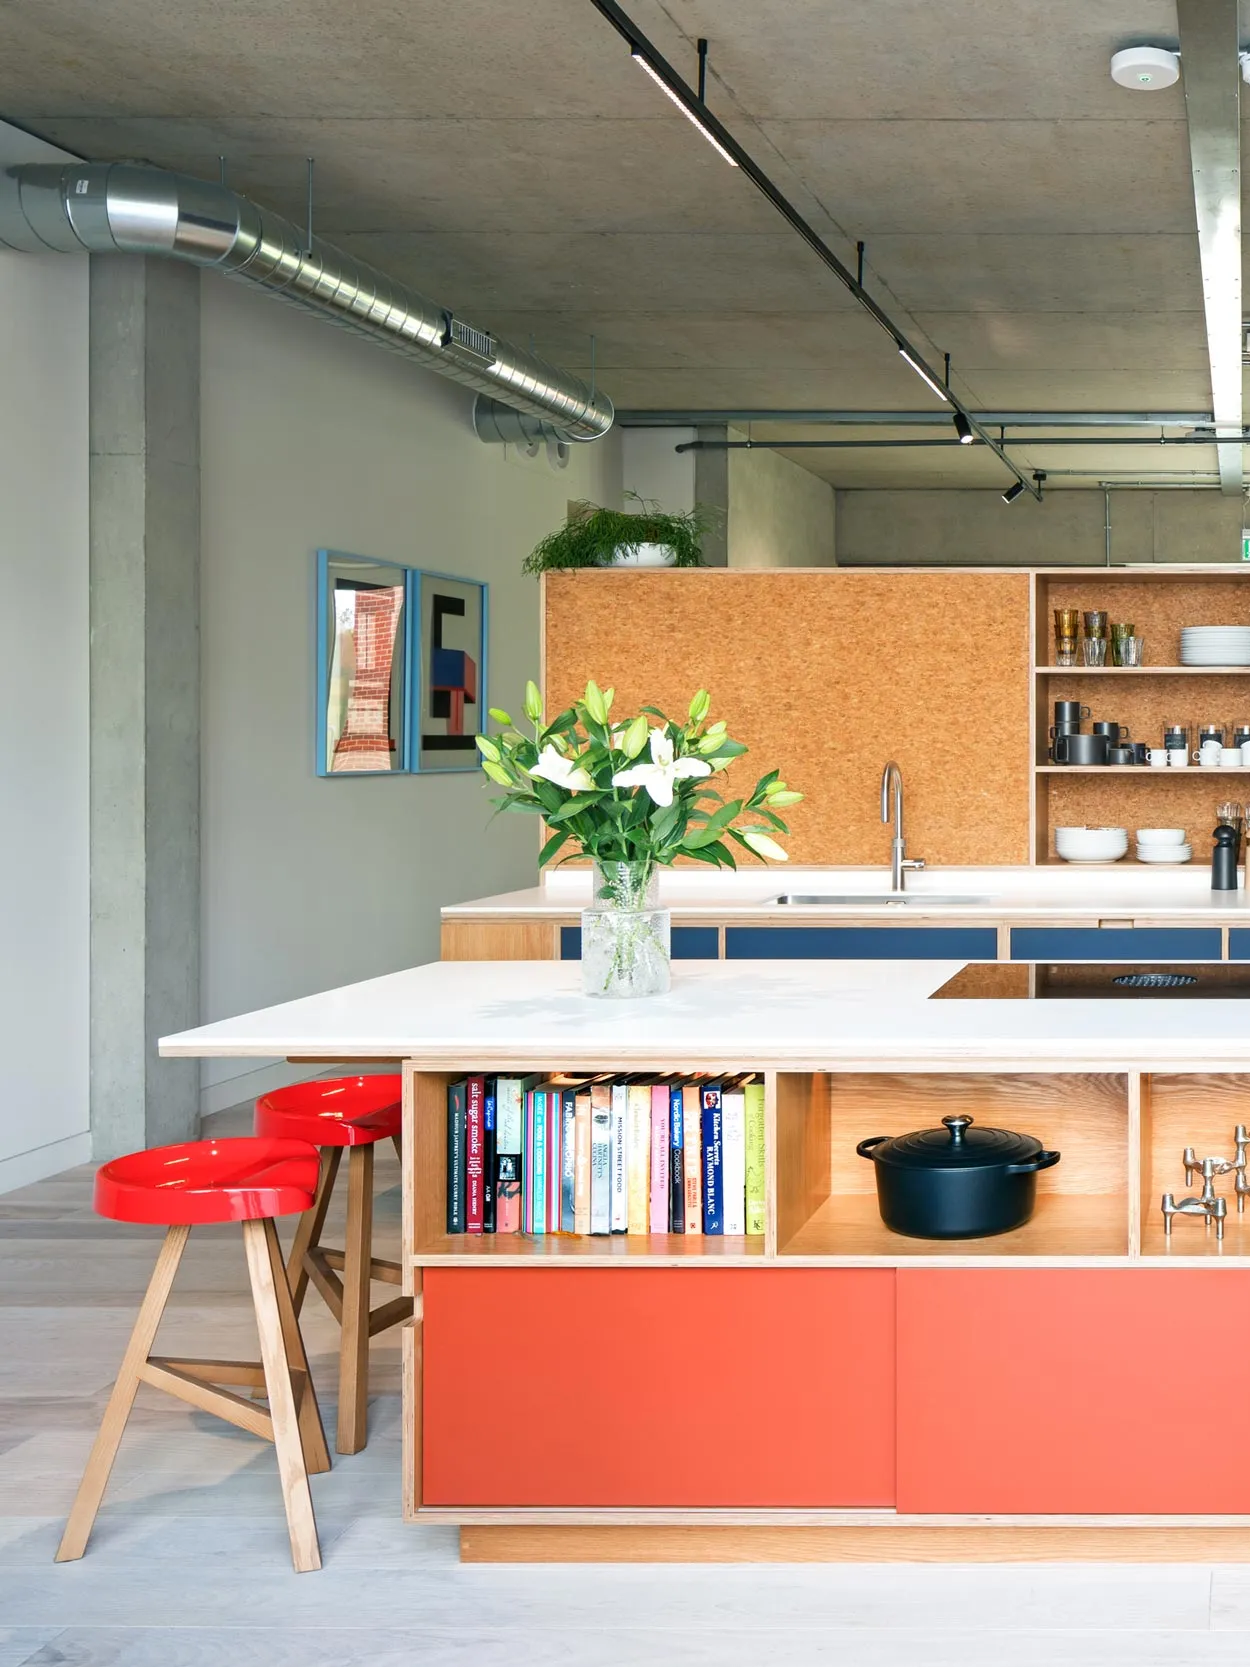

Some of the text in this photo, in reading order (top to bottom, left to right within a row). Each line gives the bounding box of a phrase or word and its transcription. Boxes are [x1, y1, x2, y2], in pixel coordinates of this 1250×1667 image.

[469, 1082, 482, 1154] salt sugar smoke
[673, 1099, 682, 1184] Nordic Bakery Cookbook
[748, 1120, 756, 1151] Cooking
[756, 1098, 766, 1168] Forgotten Skills
[706, 1146, 715, 1215] RAYMOND BLANC
[713, 1140, 721, 1166] Secrets
